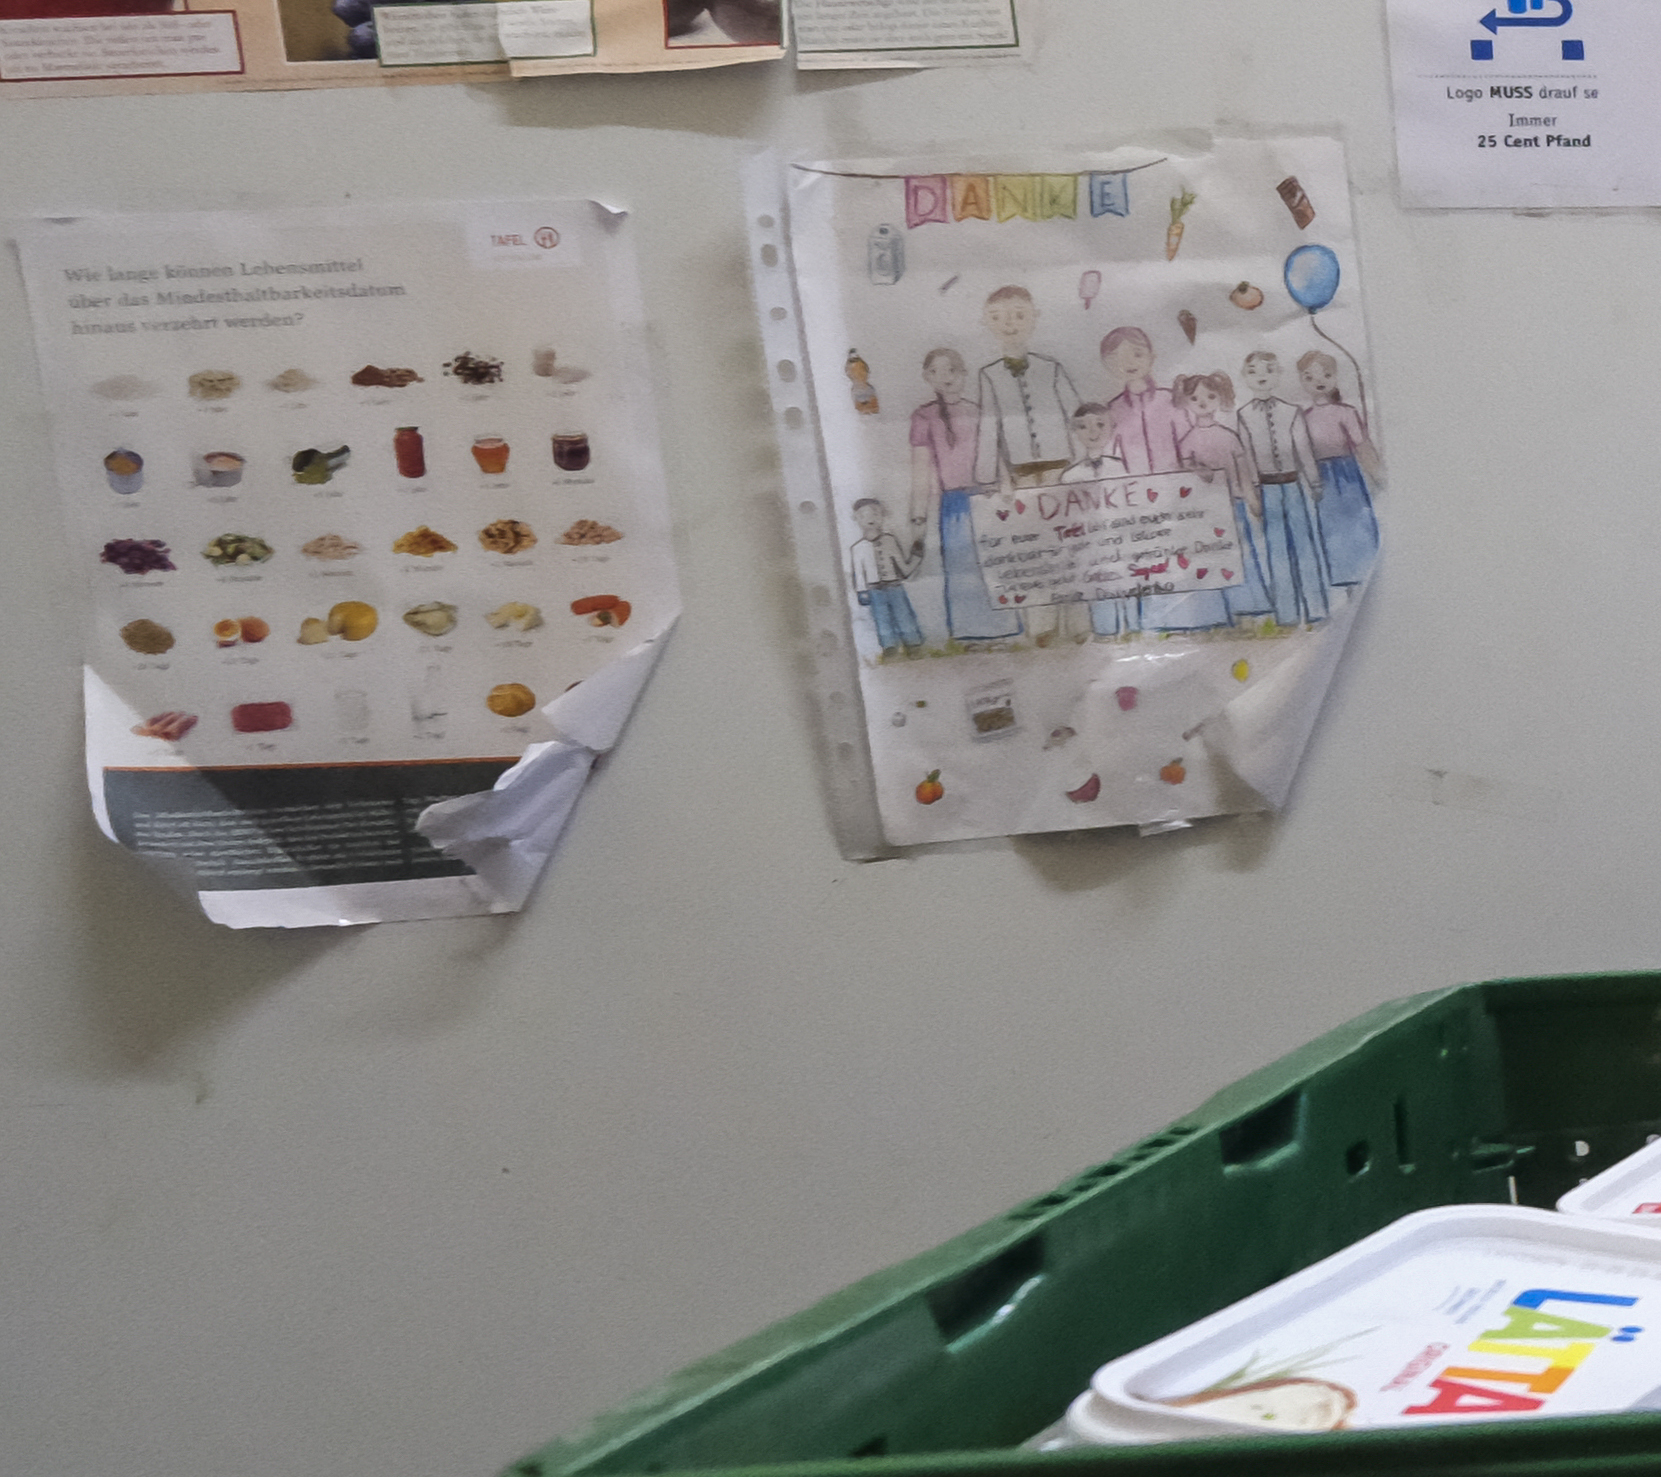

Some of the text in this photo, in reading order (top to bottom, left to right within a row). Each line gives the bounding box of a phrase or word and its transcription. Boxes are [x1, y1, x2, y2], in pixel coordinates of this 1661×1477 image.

[1446, 85, 1483, 103] Logo
[1489, 85, 1534, 99] MUSS
[1538, 85, 1578, 99] drauf
[1508, 113, 1558, 127] Immer
[1477, 134, 1592, 148] 25 Cent Pfand
[912, 179, 1115, 217] DANKE
[239, 257, 365, 276] Lebensmittel
[1036, 480, 1139, 521] DANKE
[1400, 1288, 1645, 1415] LÄTTA
